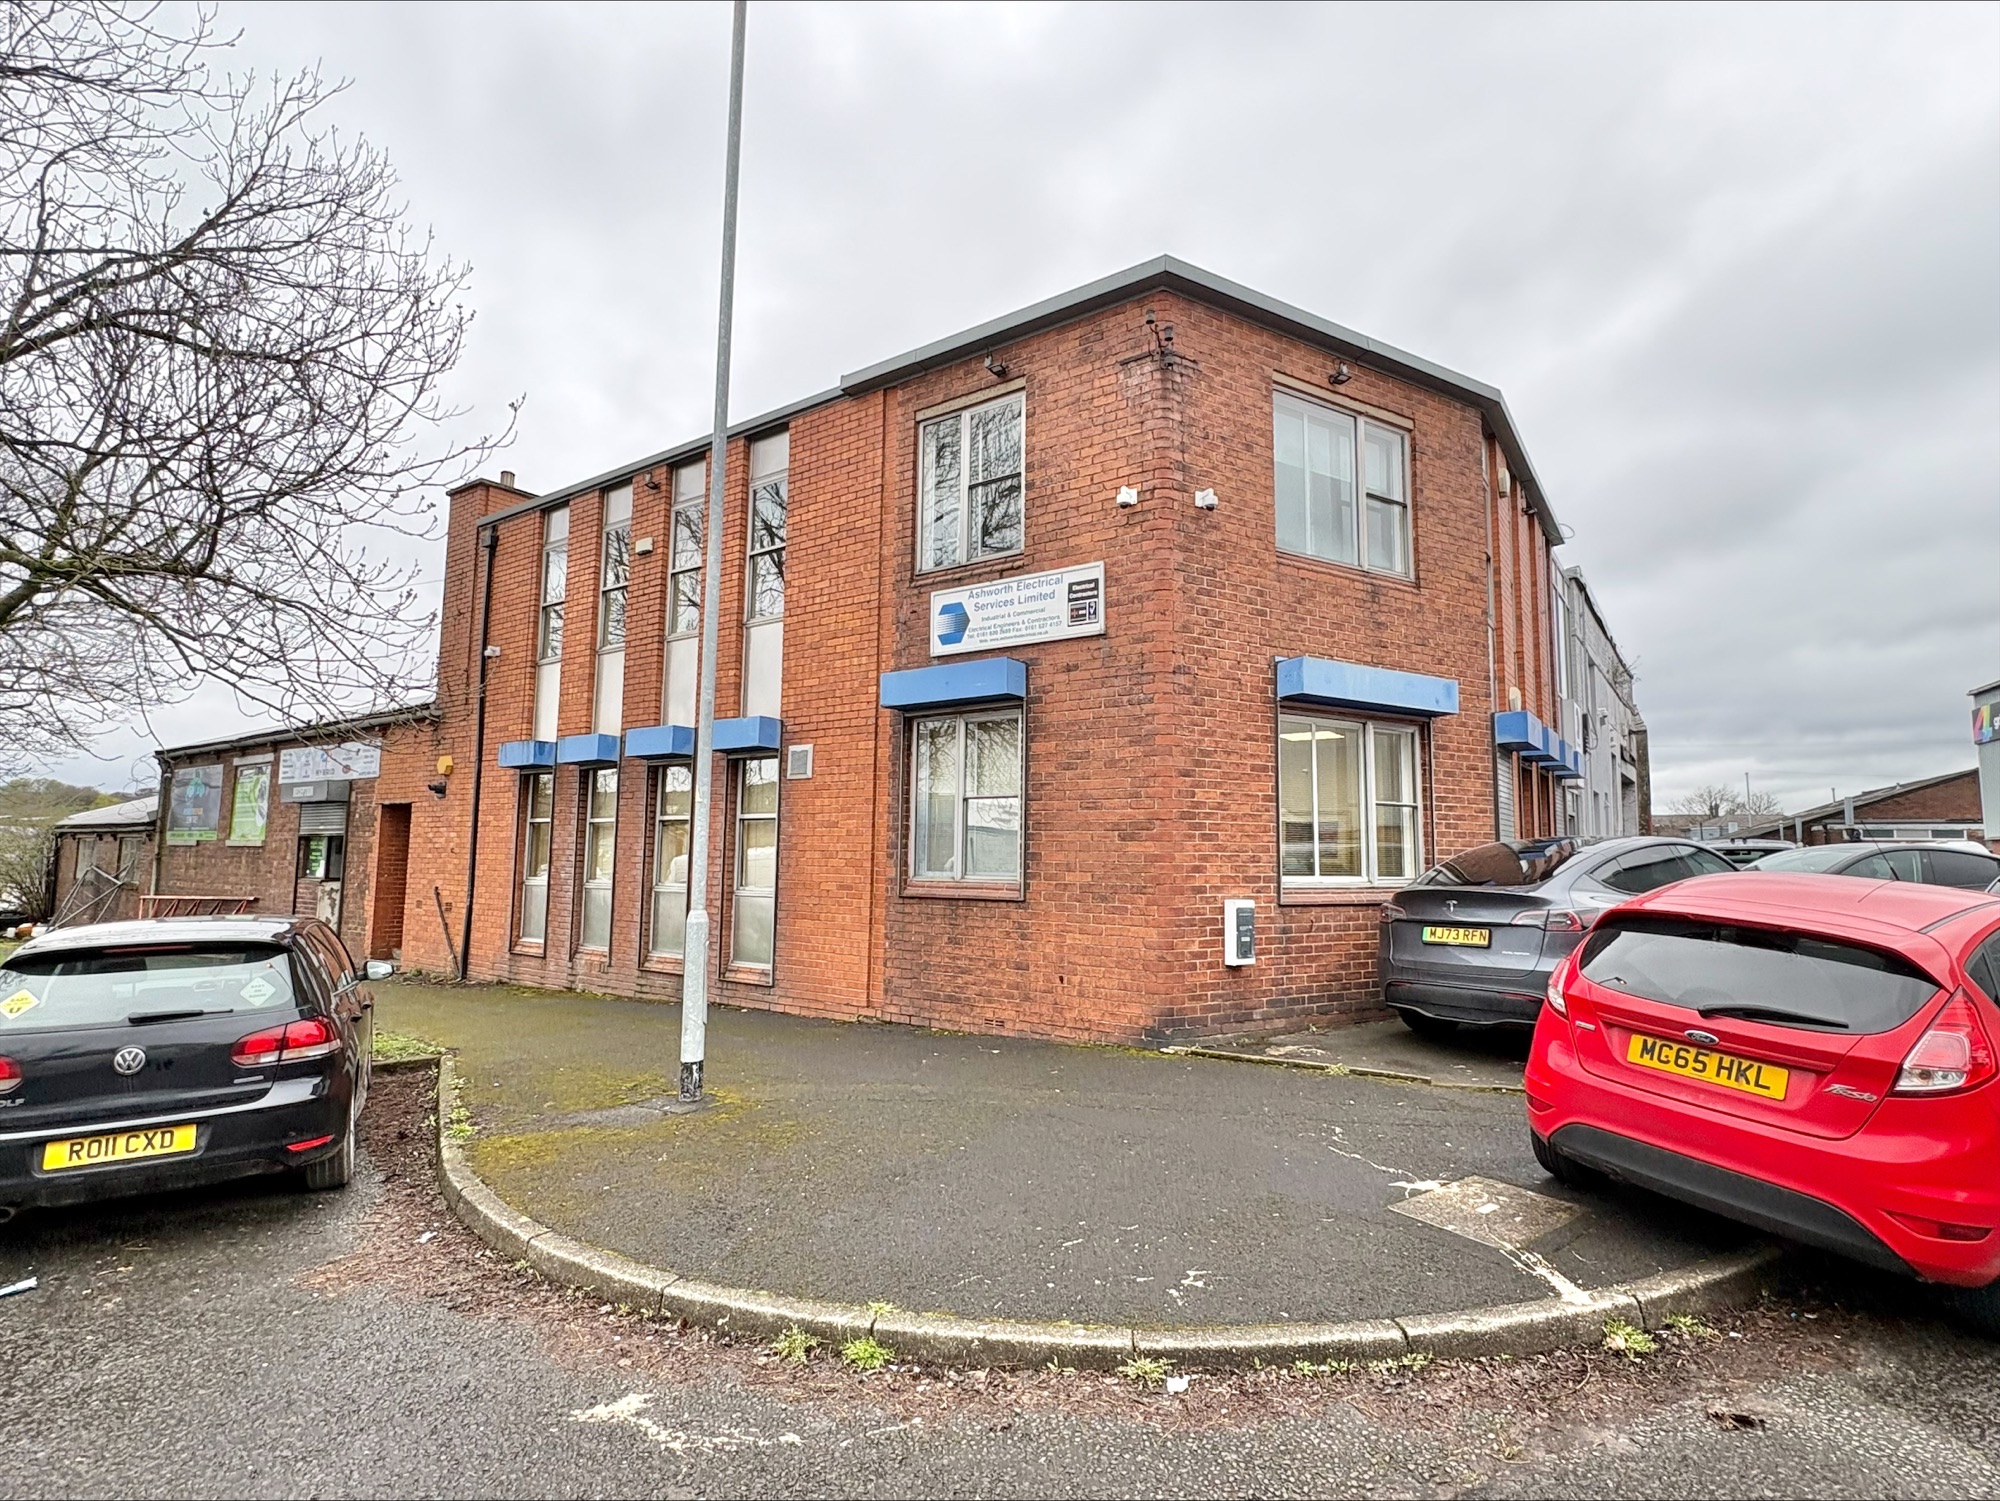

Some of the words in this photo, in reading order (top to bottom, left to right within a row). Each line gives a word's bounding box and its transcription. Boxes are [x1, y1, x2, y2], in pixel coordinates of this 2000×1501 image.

[968, 584, 1013, 600] Ashworth
[1016, 574, 1064, 591] Electrical
[974, 598, 1015, 612] Services
[1018, 589, 1056, 605] Limited
[968, 624, 992, 633] Electrical
[993, 620, 1020, 631] Engineers
[1027, 615, 1061, 624] Contractors
[981, 612, 1006, 622] Industrial
[1012, 607, 1046, 617] Commercial
[1429, 927, 1460, 940] MJ73
[1463, 929, 1487, 942] RFN
[1639, 1038, 1710, 1074] MC65
[1715, 1055, 1771, 1091] HKL
[1824, 1083, 1877, 1103] Fiesta
[68, 1135, 117, 1162] RO11
[125, 1129, 175, 1154] CXD
